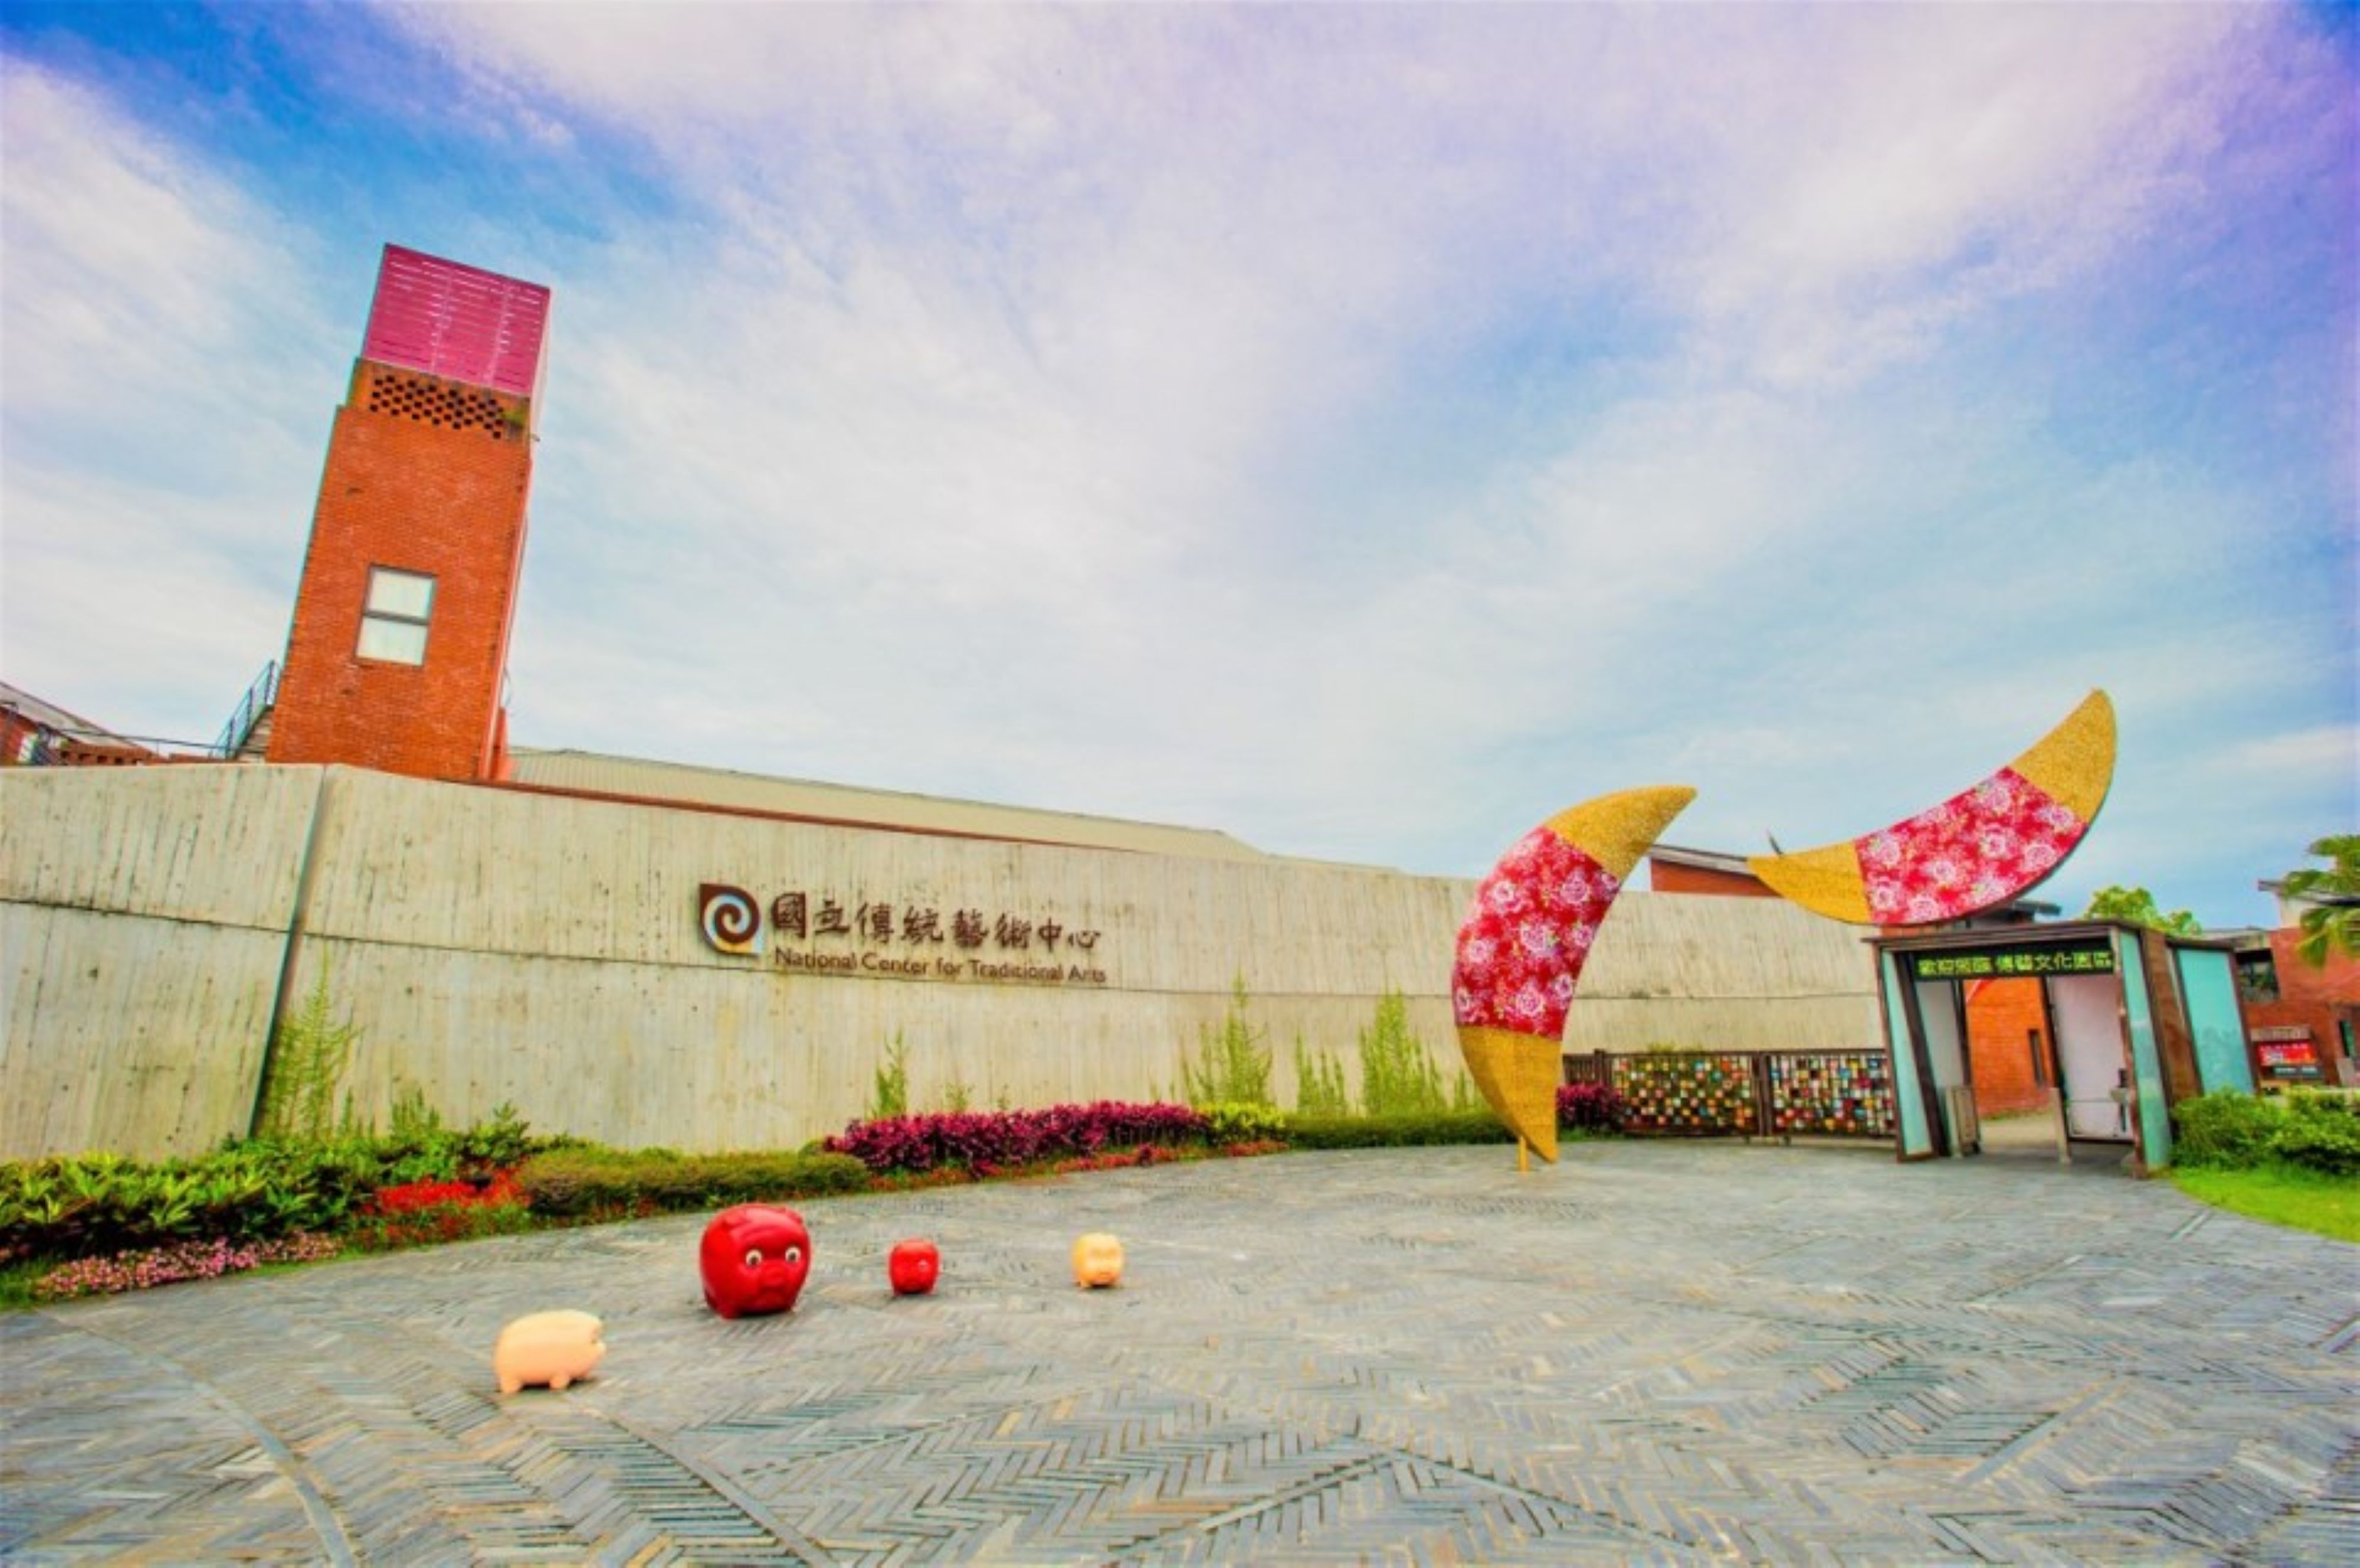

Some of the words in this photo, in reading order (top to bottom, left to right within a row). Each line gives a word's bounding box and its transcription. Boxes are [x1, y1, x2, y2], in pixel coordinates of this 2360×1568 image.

[771, 892, 1101, 953] 國立傳統藝術中心
[775, 947, 857, 970] National
[862, 953, 930, 973] Center
[936, 957, 962, 975] for
[969, 960, 1063, 980] Traditional
[1068, 966, 1105, 983] Arts
